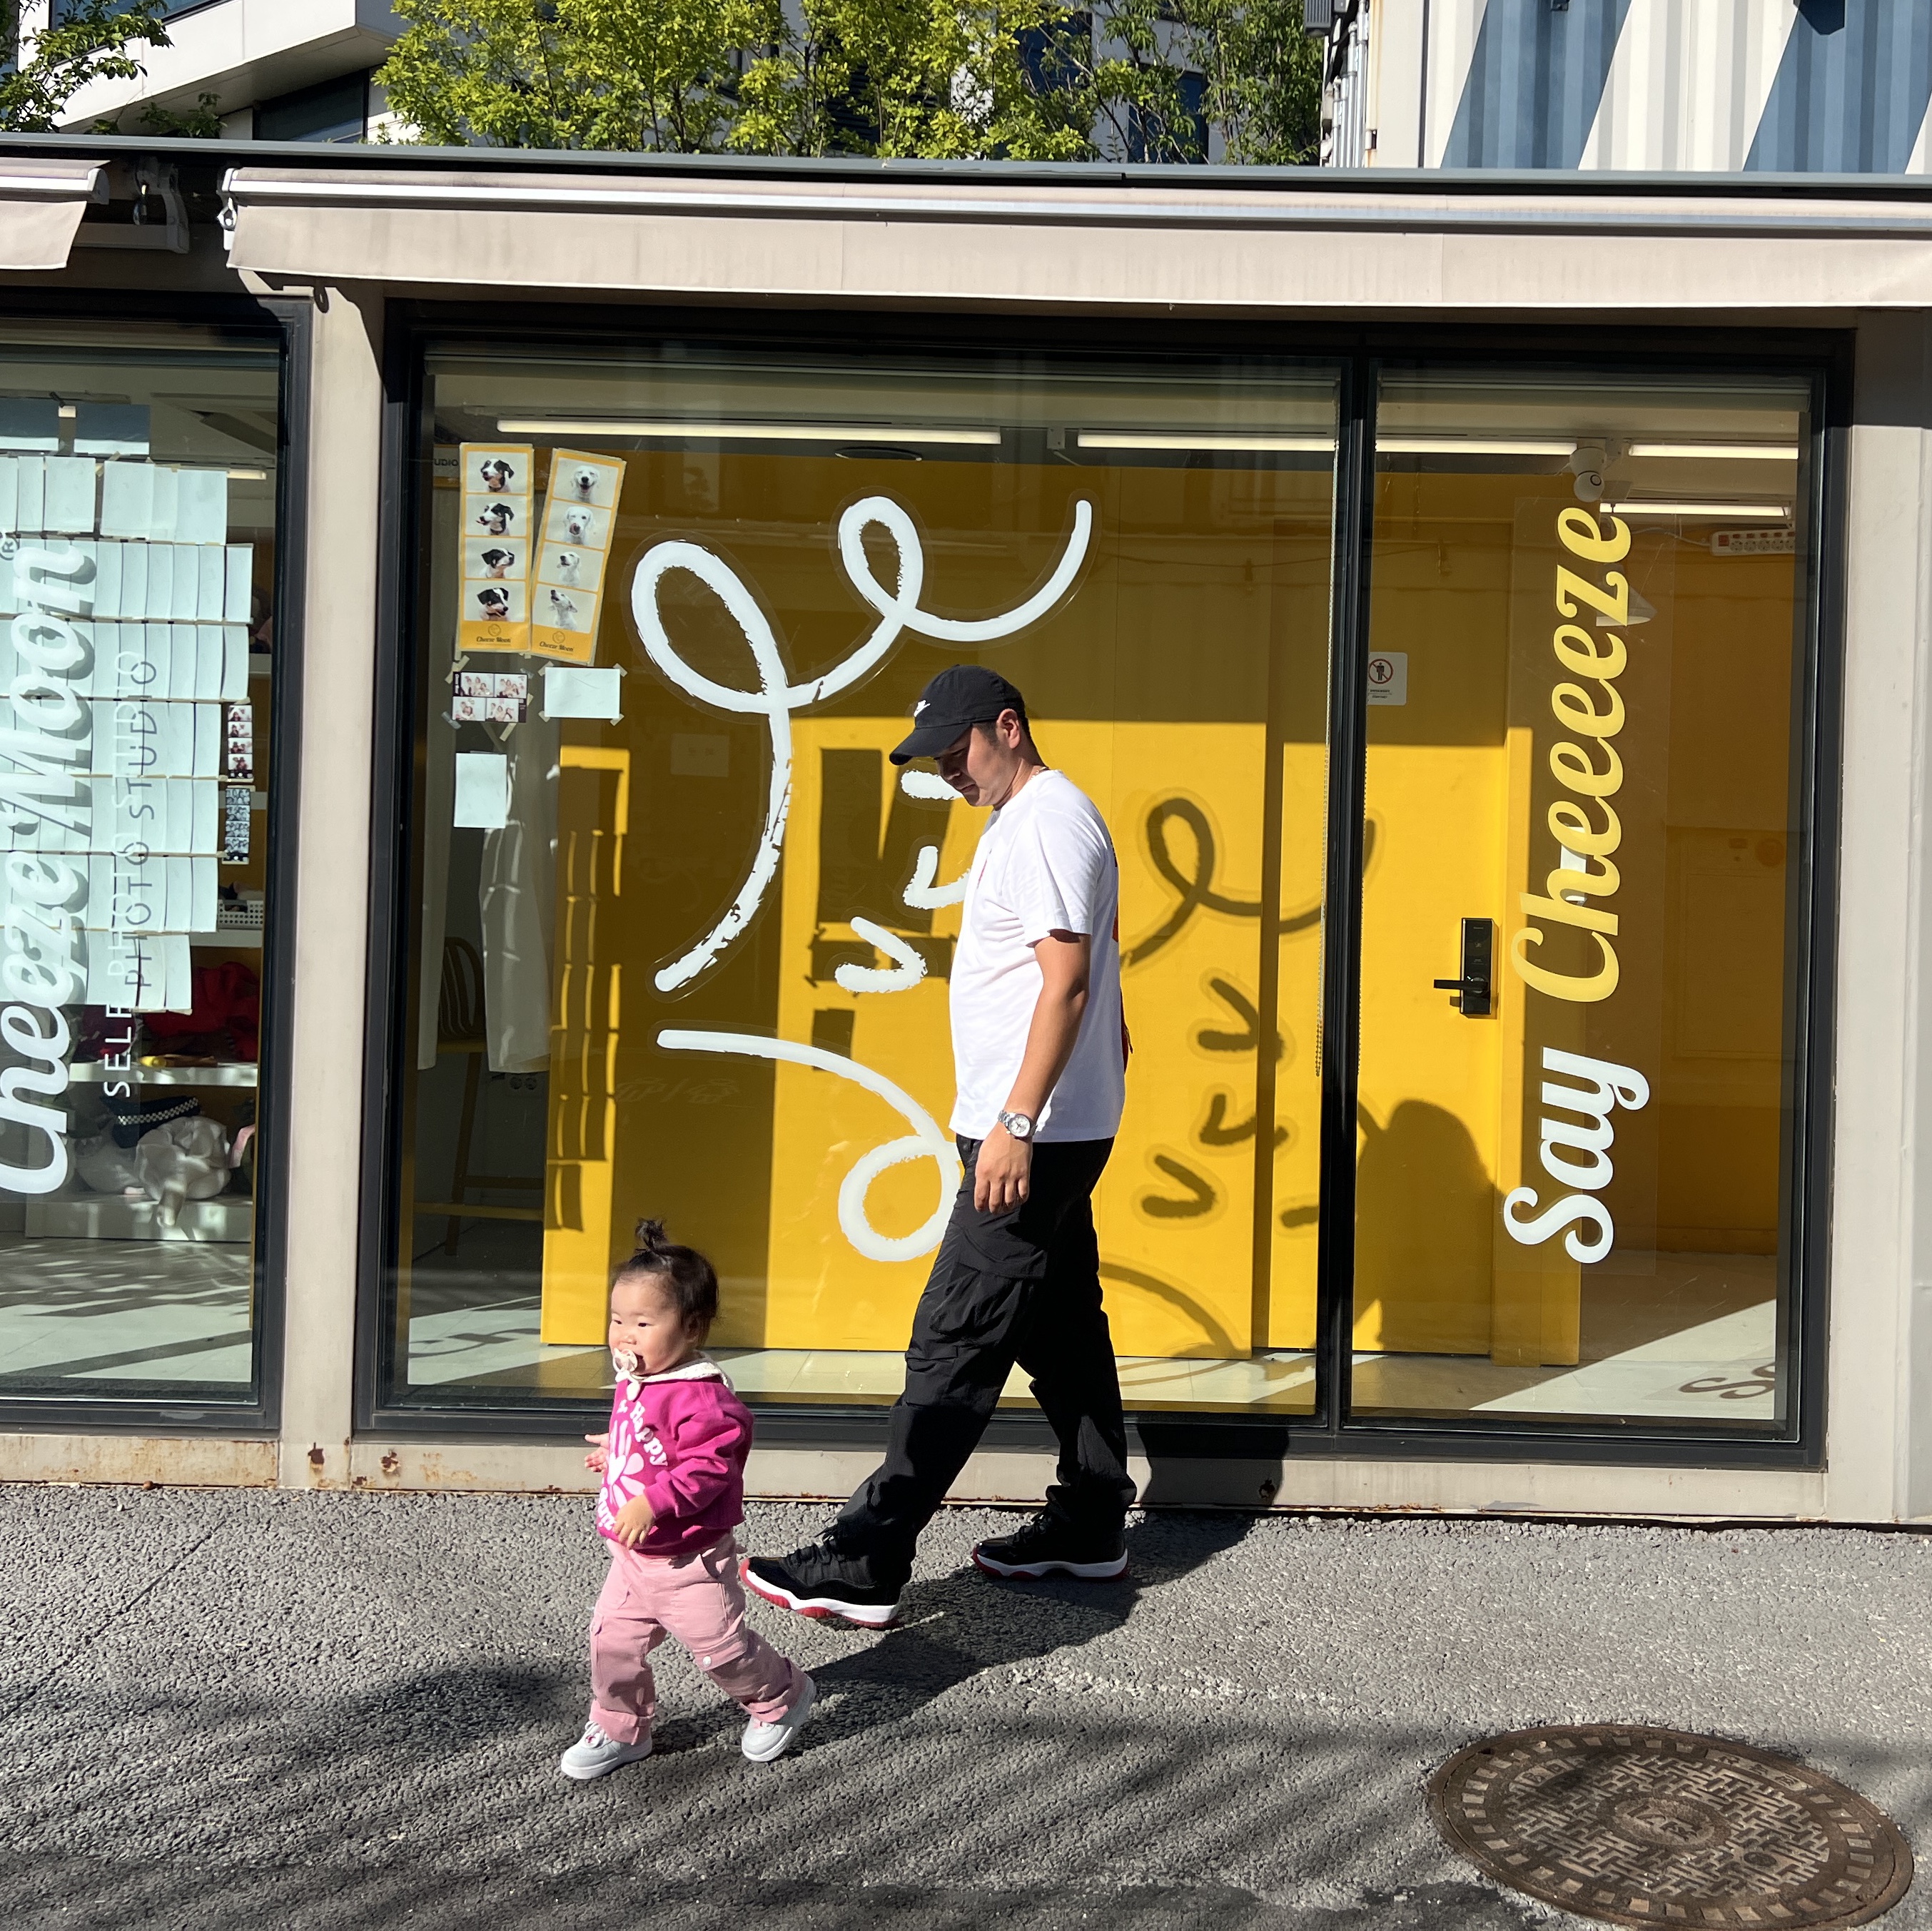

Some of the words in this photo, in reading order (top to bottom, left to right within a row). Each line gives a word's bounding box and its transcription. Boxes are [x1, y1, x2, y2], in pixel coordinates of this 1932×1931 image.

[0, 545, 85, 828] Moon
[111, 650, 144, 809] STUDIO
[1511, 507, 1631, 1003] Cheeeeze
[107, 832, 136, 977] PHOTO
[0, 851, 79, 1195] Cheeze
[103, 1001, 132, 1098] SELF
[1503, 1046, 1650, 1264] Say
[629, 1401, 668, 1466] Happy
